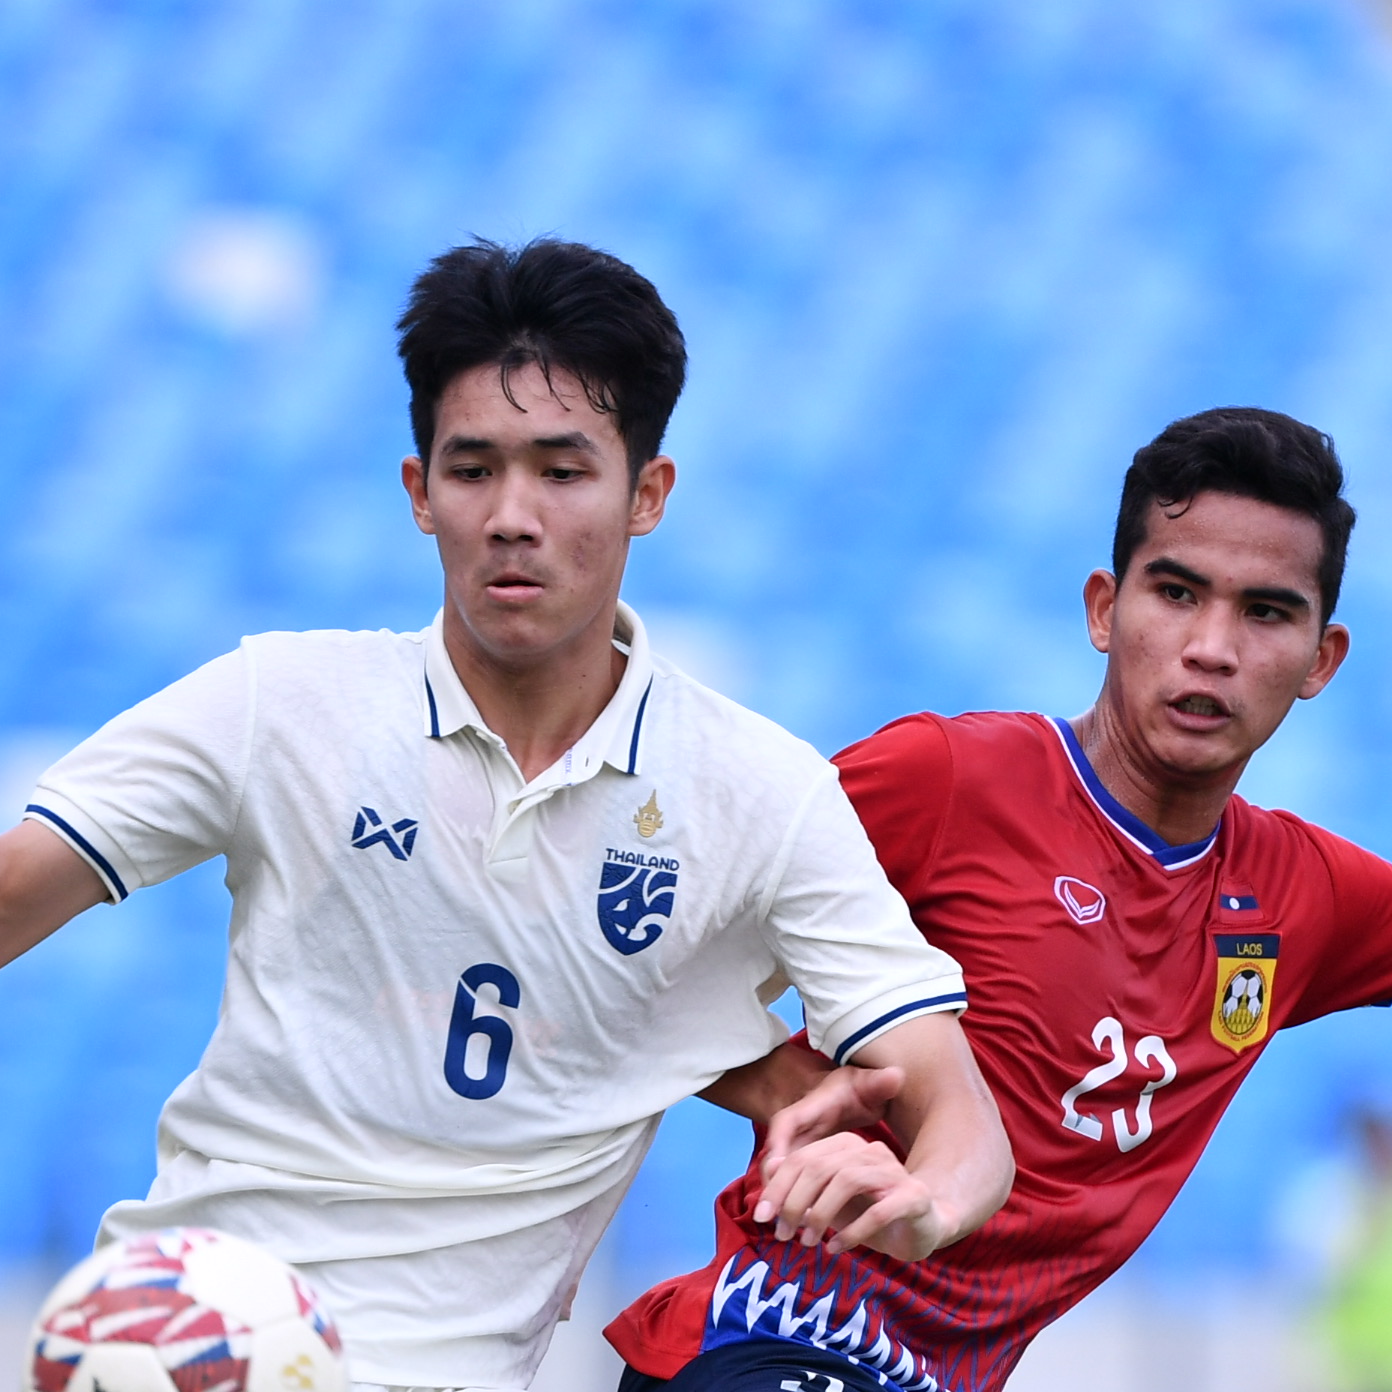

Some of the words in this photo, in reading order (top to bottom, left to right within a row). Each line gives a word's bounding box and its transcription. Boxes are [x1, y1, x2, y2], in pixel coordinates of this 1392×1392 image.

[605, 847, 680, 872] THAILAND
[1236, 943, 1263, 956] LAOS
[443, 962, 521, 1101] 6
[1060, 1016, 1178, 1153] 23
